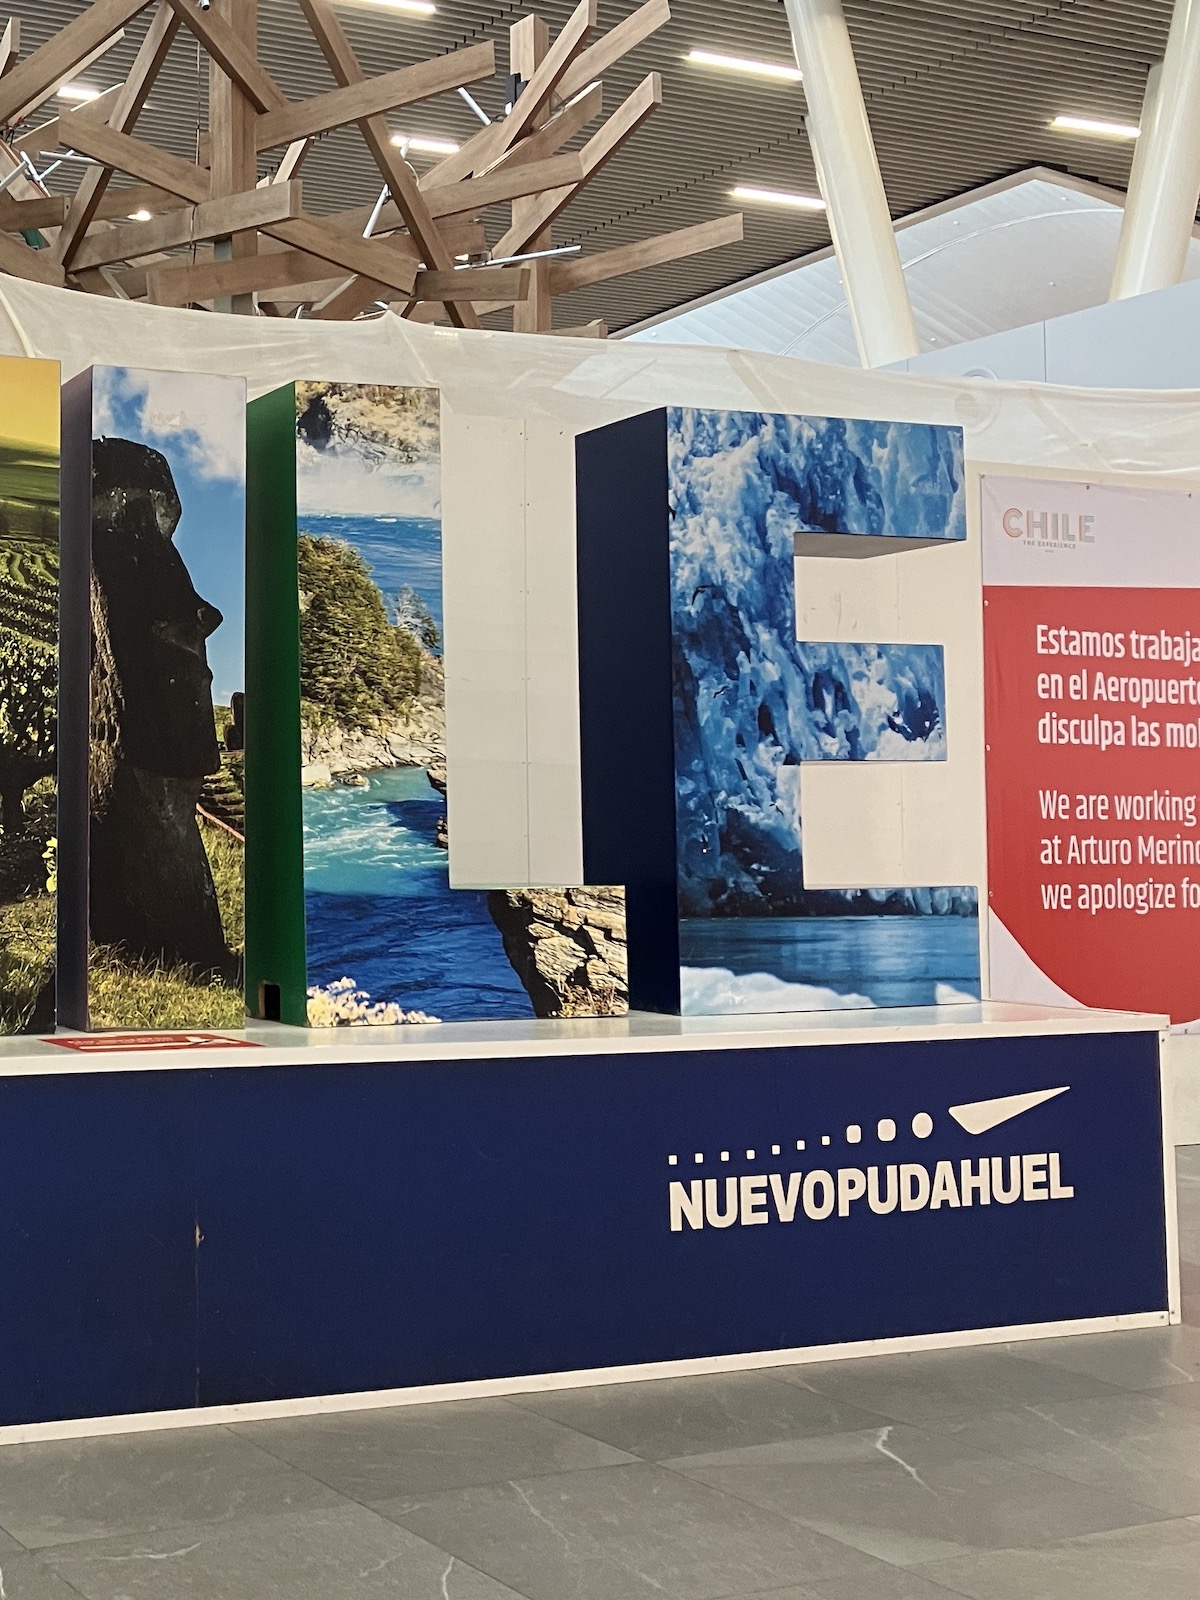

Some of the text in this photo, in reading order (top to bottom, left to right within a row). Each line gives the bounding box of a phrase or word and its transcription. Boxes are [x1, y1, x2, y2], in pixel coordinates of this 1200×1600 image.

[1002, 507, 1095, 543] CHILE
[1037, 541, 1076, 549] EXPERIENCE
[1036, 624, 1125, 658] Estamos
[1037, 672, 1063, 699] en
[1069, 668, 1087, 700] el
[1037, 711, 1125, 751] disculpa
[1131, 715, 1161, 747] las
[1038, 789, 1197, 827] We are working
[1040, 835, 1062, 865] at
[1067, 835, 1132, 865] Arturo
[1040, 884, 1072, 910] we
[1078, 877, 1176, 915] apologize
[668, 1152, 1075, 1232] NUEVOPUDAHUEL
